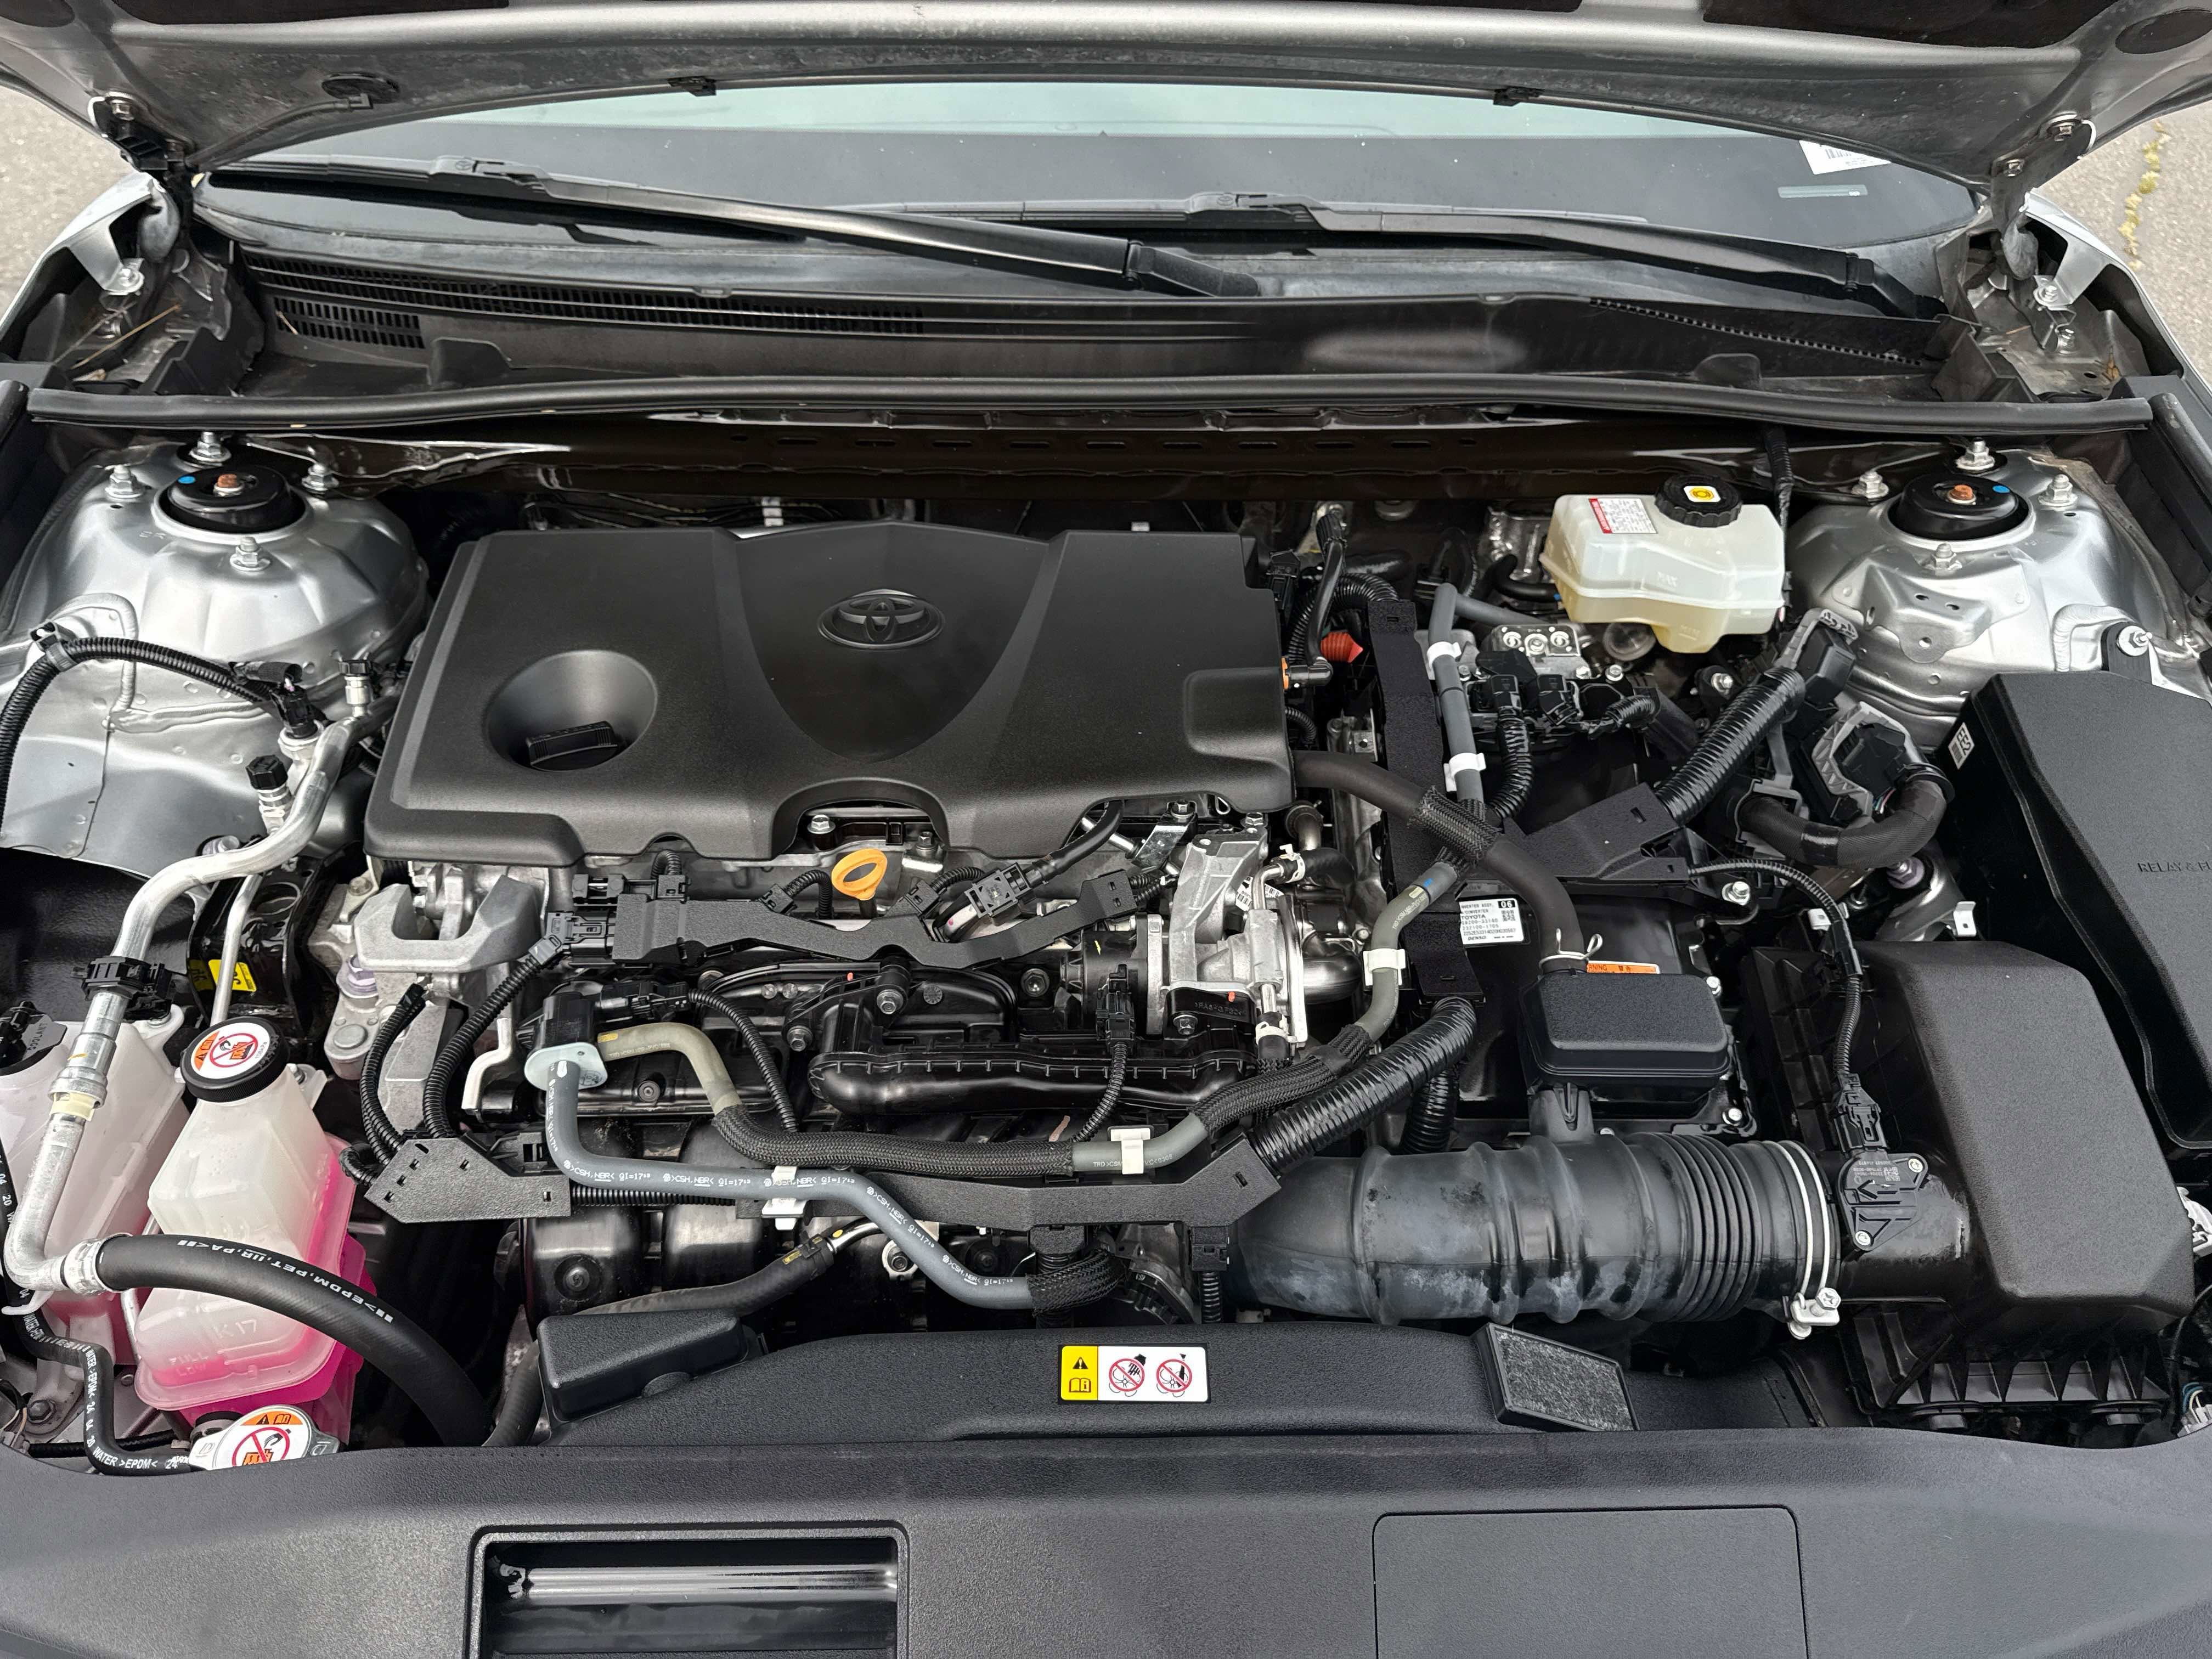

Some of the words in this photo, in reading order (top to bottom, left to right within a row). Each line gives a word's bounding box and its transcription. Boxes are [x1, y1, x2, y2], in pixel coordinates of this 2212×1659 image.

[1956, 727, 1971, 755] EE2
[2137, 862, 2181, 872] RELAY
[86, 1348, 97, 1369] WATER
[92, 1446, 119, 1466] WATER
